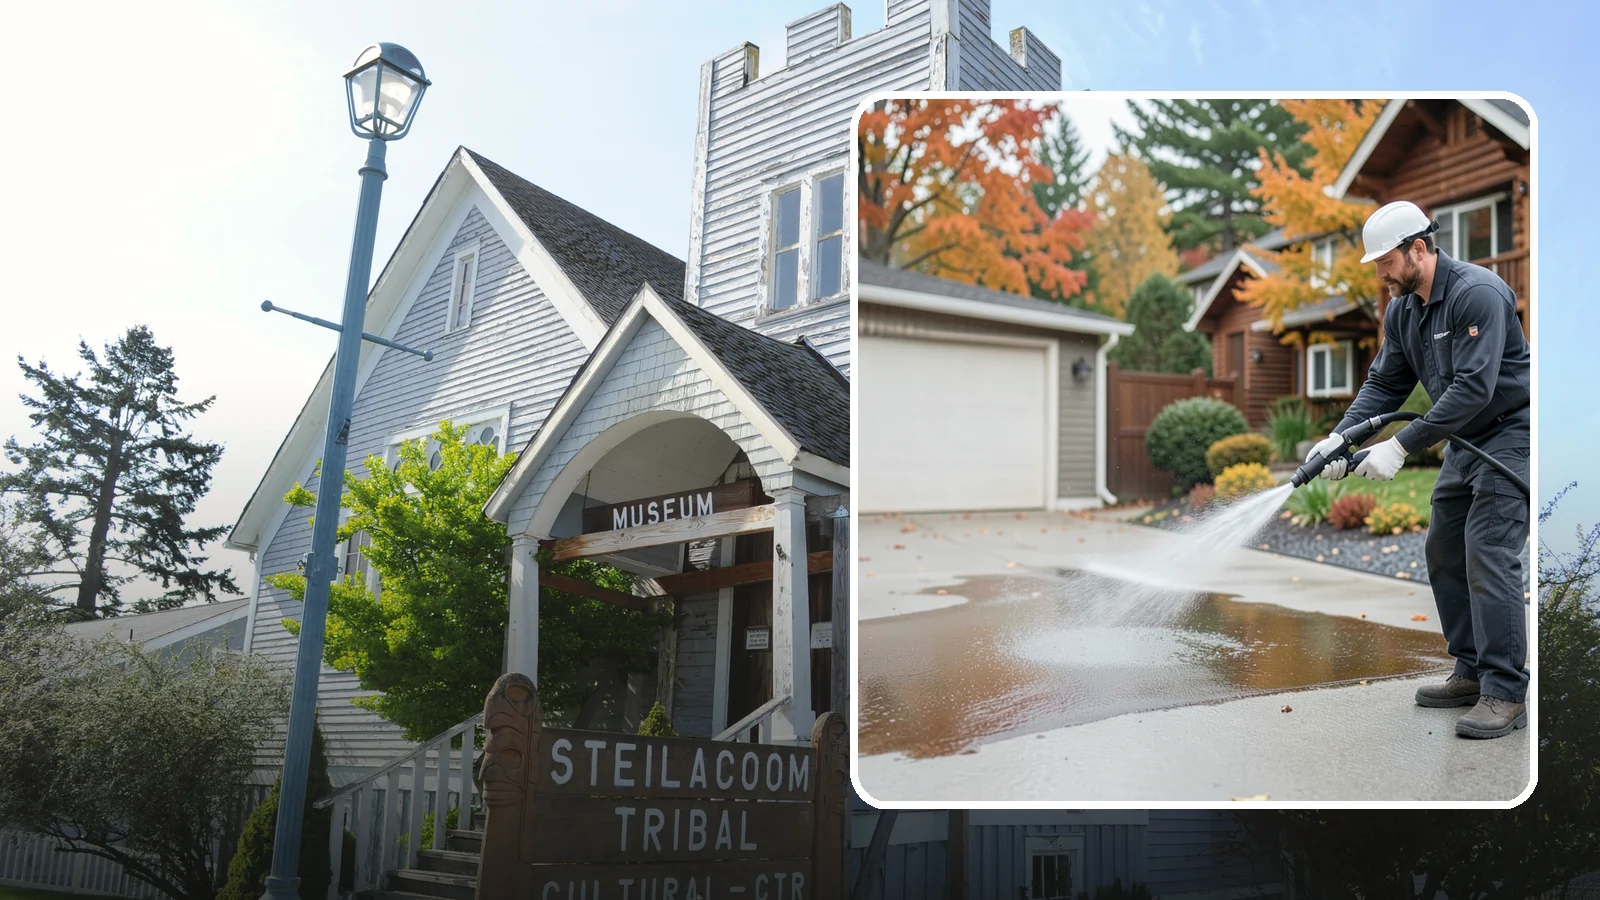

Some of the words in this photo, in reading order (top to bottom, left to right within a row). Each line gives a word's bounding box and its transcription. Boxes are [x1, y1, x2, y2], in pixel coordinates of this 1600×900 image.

[613, 492, 713, 530] MUSEUM
[551, 739, 809, 792] STEILACOOM
[615, 807, 757, 851] TRIBAL
